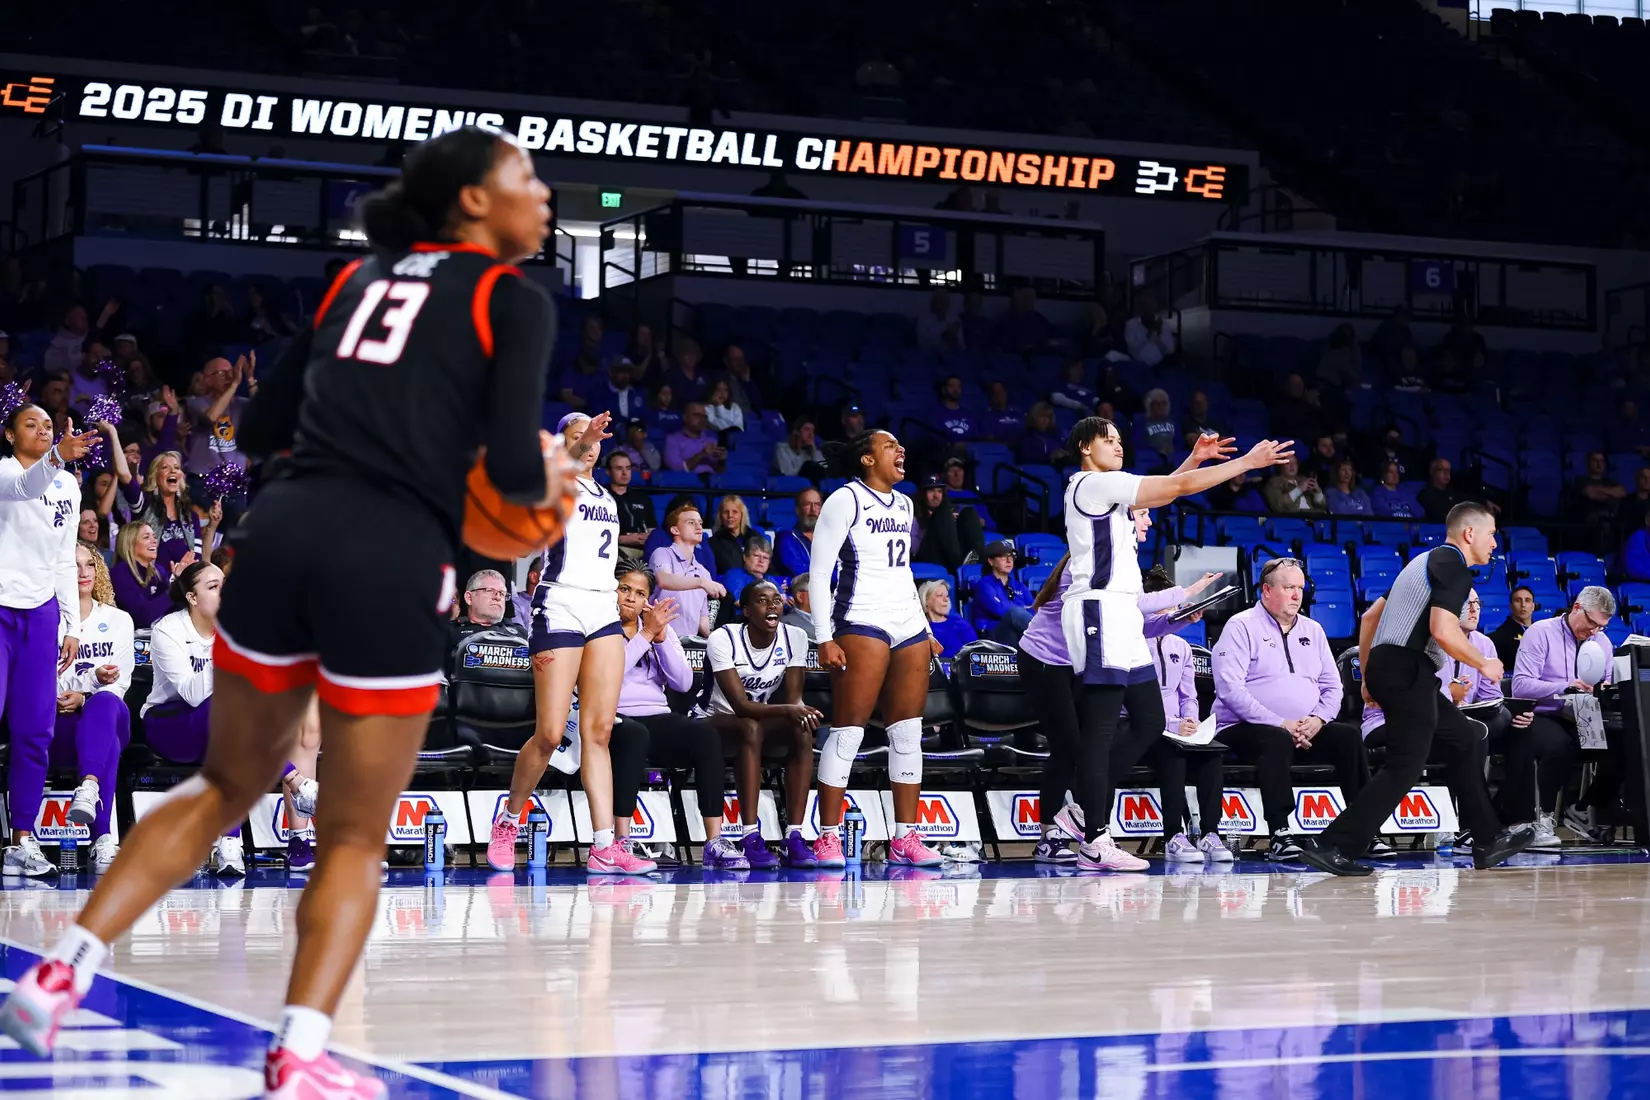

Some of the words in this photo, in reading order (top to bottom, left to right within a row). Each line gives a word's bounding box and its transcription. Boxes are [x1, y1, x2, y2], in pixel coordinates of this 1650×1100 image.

[79, 82, 208, 124] 2025
[220, 93, 278, 130] DI
[291, 98, 504, 141] WOMEN'S
[517, 116, 783, 167] BASKETBALL
[795, 137, 1116, 189] CHAMPIONSHIP
[602, 192, 621, 207] EXIT
[914, 231, 930, 253] 5
[1426, 267, 1441, 288] 6
[336, 279, 432, 365] 13
[598, 529, 612, 559] 2
[887, 539, 906, 567] 12
[479, 645, 513, 657] MARCH
[484, 655, 529, 667] MADNESS
[980, 654, 1010, 664] MARCH
[986, 663, 1018, 672] MADNES
[1125, 821, 1163, 829] Marathon
[1400, 817, 1436, 825] Marathon
[40, 827, 88, 835] Marathon
